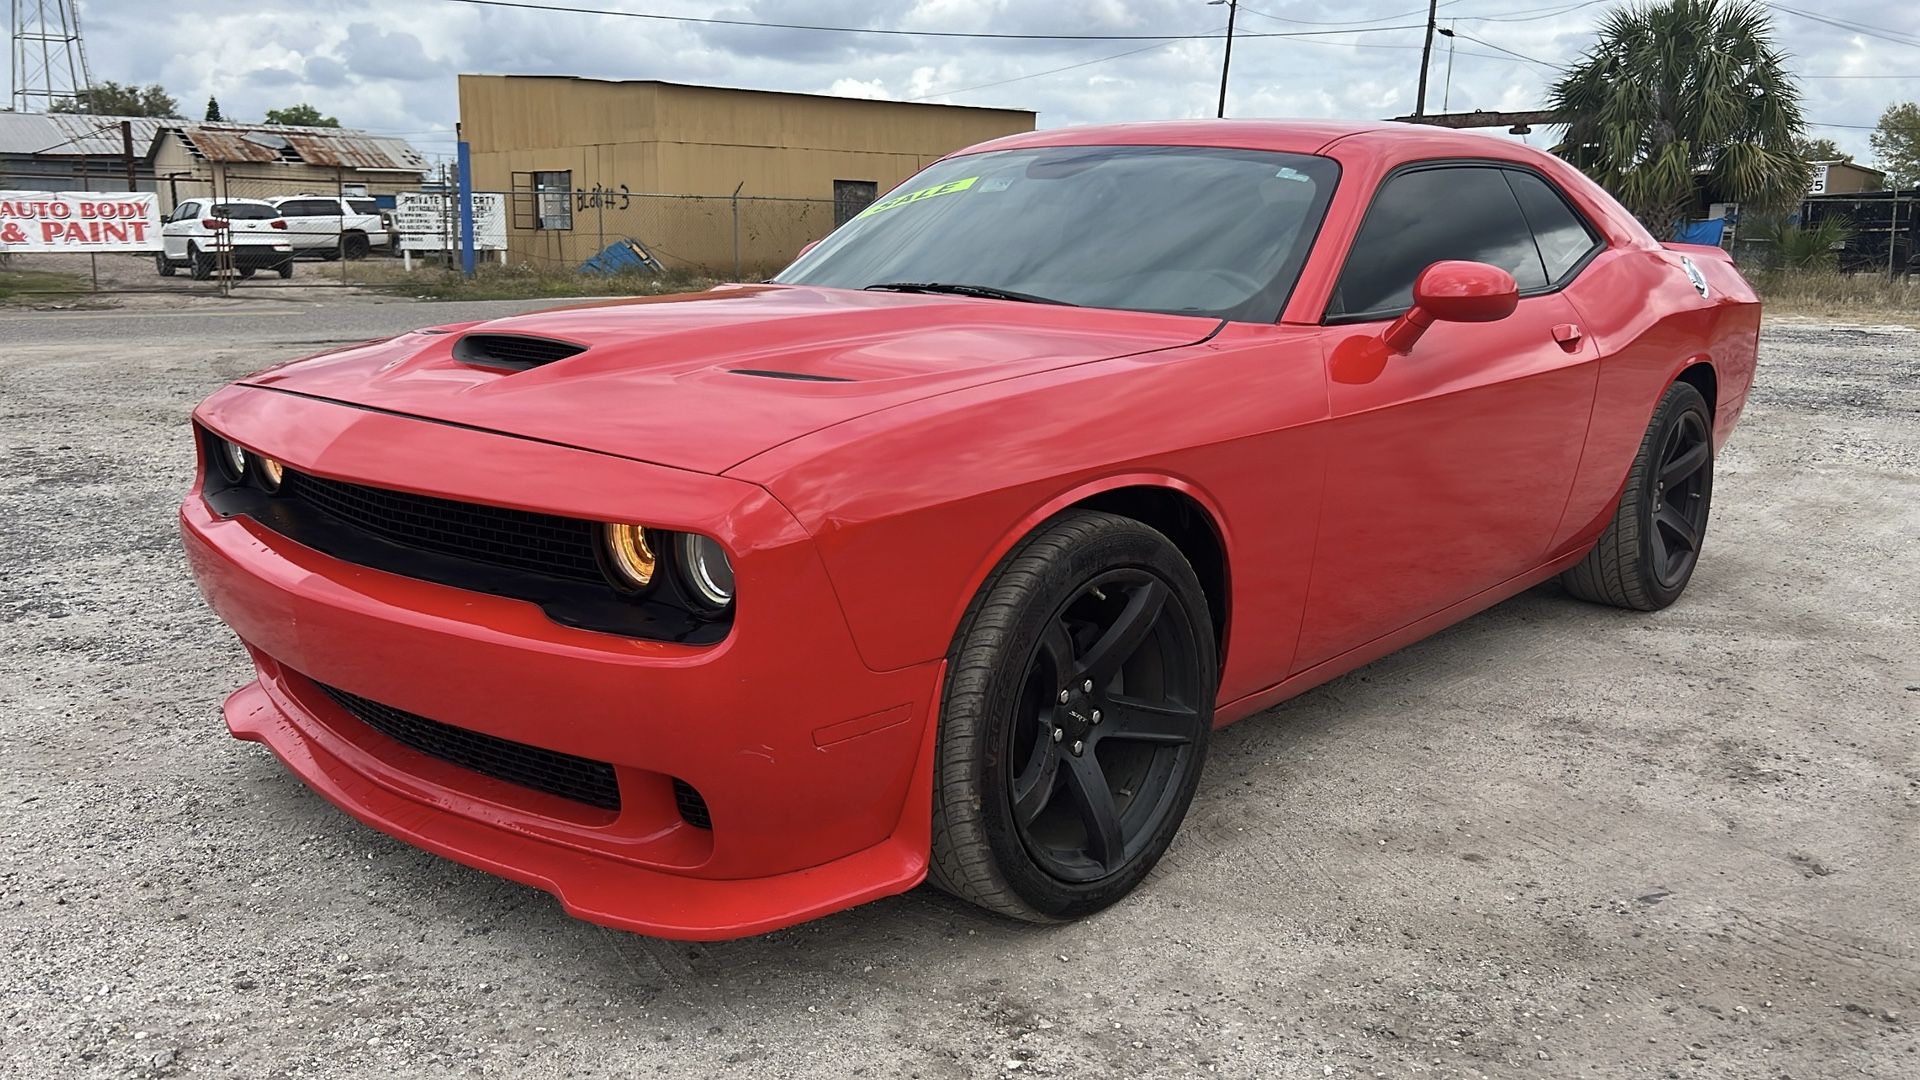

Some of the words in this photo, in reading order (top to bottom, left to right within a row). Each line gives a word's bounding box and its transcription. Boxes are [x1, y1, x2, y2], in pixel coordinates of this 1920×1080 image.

[1806, 180, 1824, 192] 25
[404, 195, 440, 205] PRIVATE
[873, 181, 962, 213] SALE
[0, 201, 70, 219] AUTO
[80, 201, 150, 219] BODY
[0, 222, 29, 245] &
[41, 221, 150, 245] PAINT
